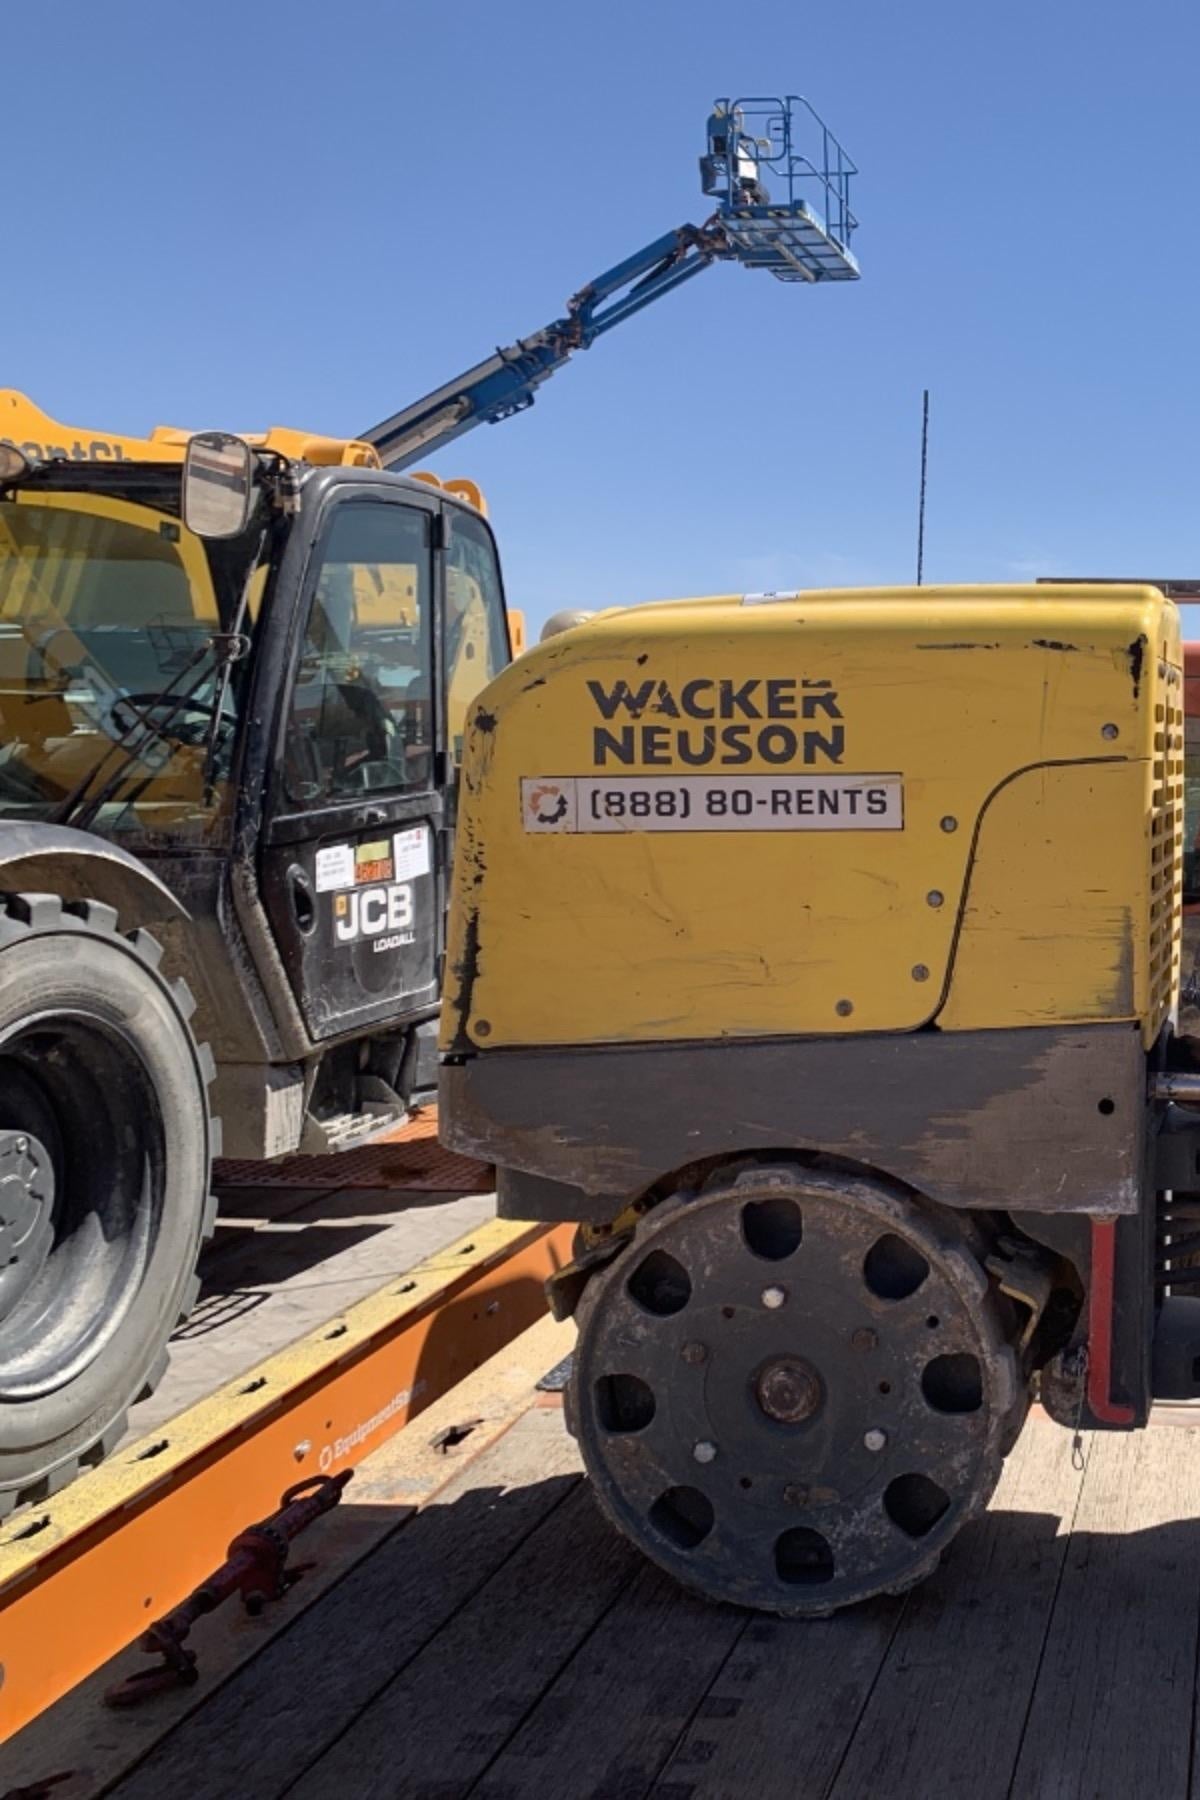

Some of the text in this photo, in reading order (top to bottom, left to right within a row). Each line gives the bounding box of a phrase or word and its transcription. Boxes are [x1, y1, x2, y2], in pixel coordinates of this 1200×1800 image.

[586, 679, 844, 720] WACKER
[592, 725, 845, 766] NEUSON
[590, 788, 888, 819] (888) 80-RENTS
[336, 884, 413, 941] JCB
